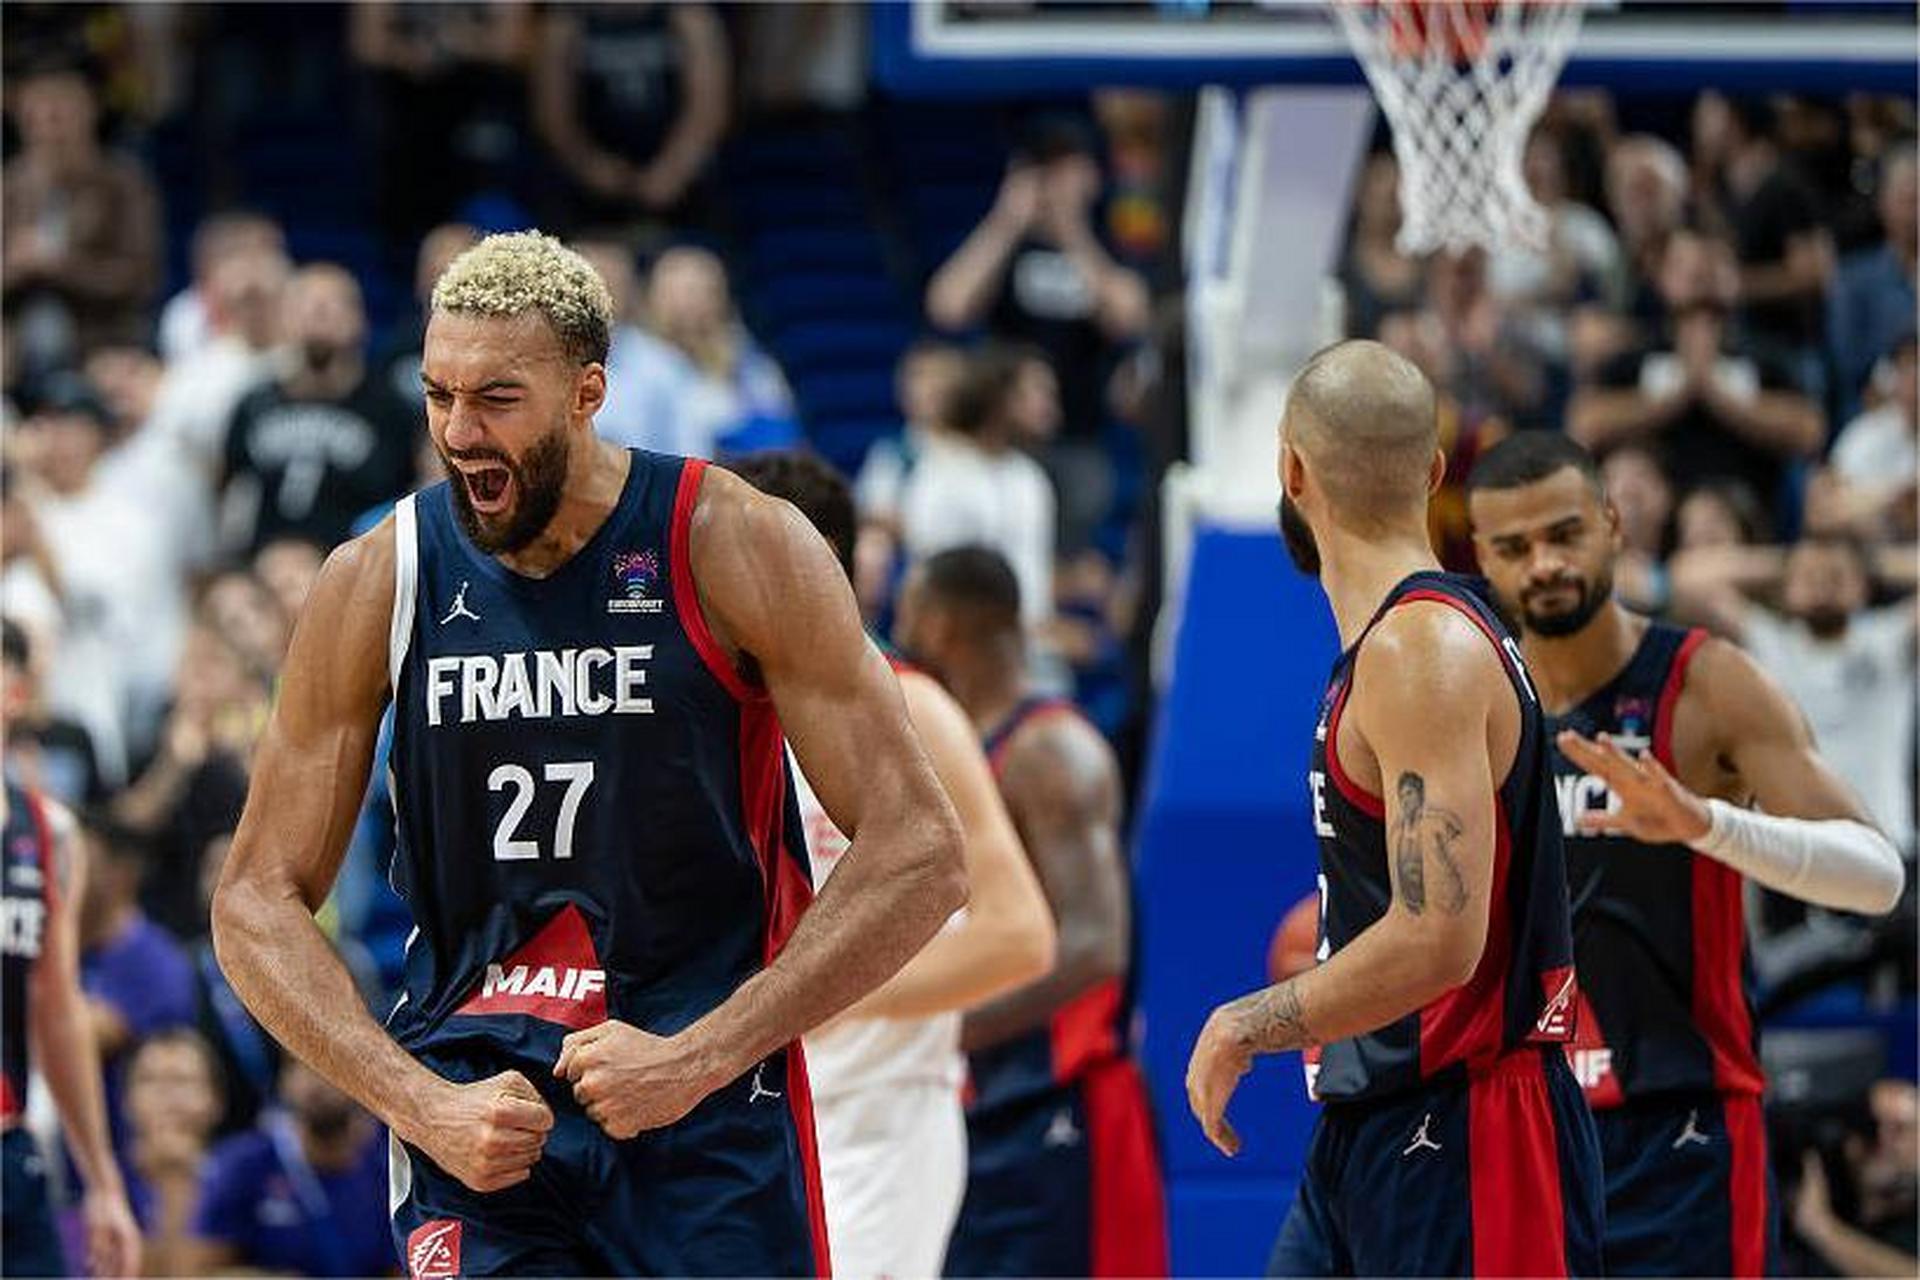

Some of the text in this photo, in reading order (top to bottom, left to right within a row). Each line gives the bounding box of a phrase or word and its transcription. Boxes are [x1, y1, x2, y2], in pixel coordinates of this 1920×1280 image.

[427, 645, 655, 727] FRANCE
[487, 761, 595, 861] 27
[483, 964, 606, 1000] MAIF
